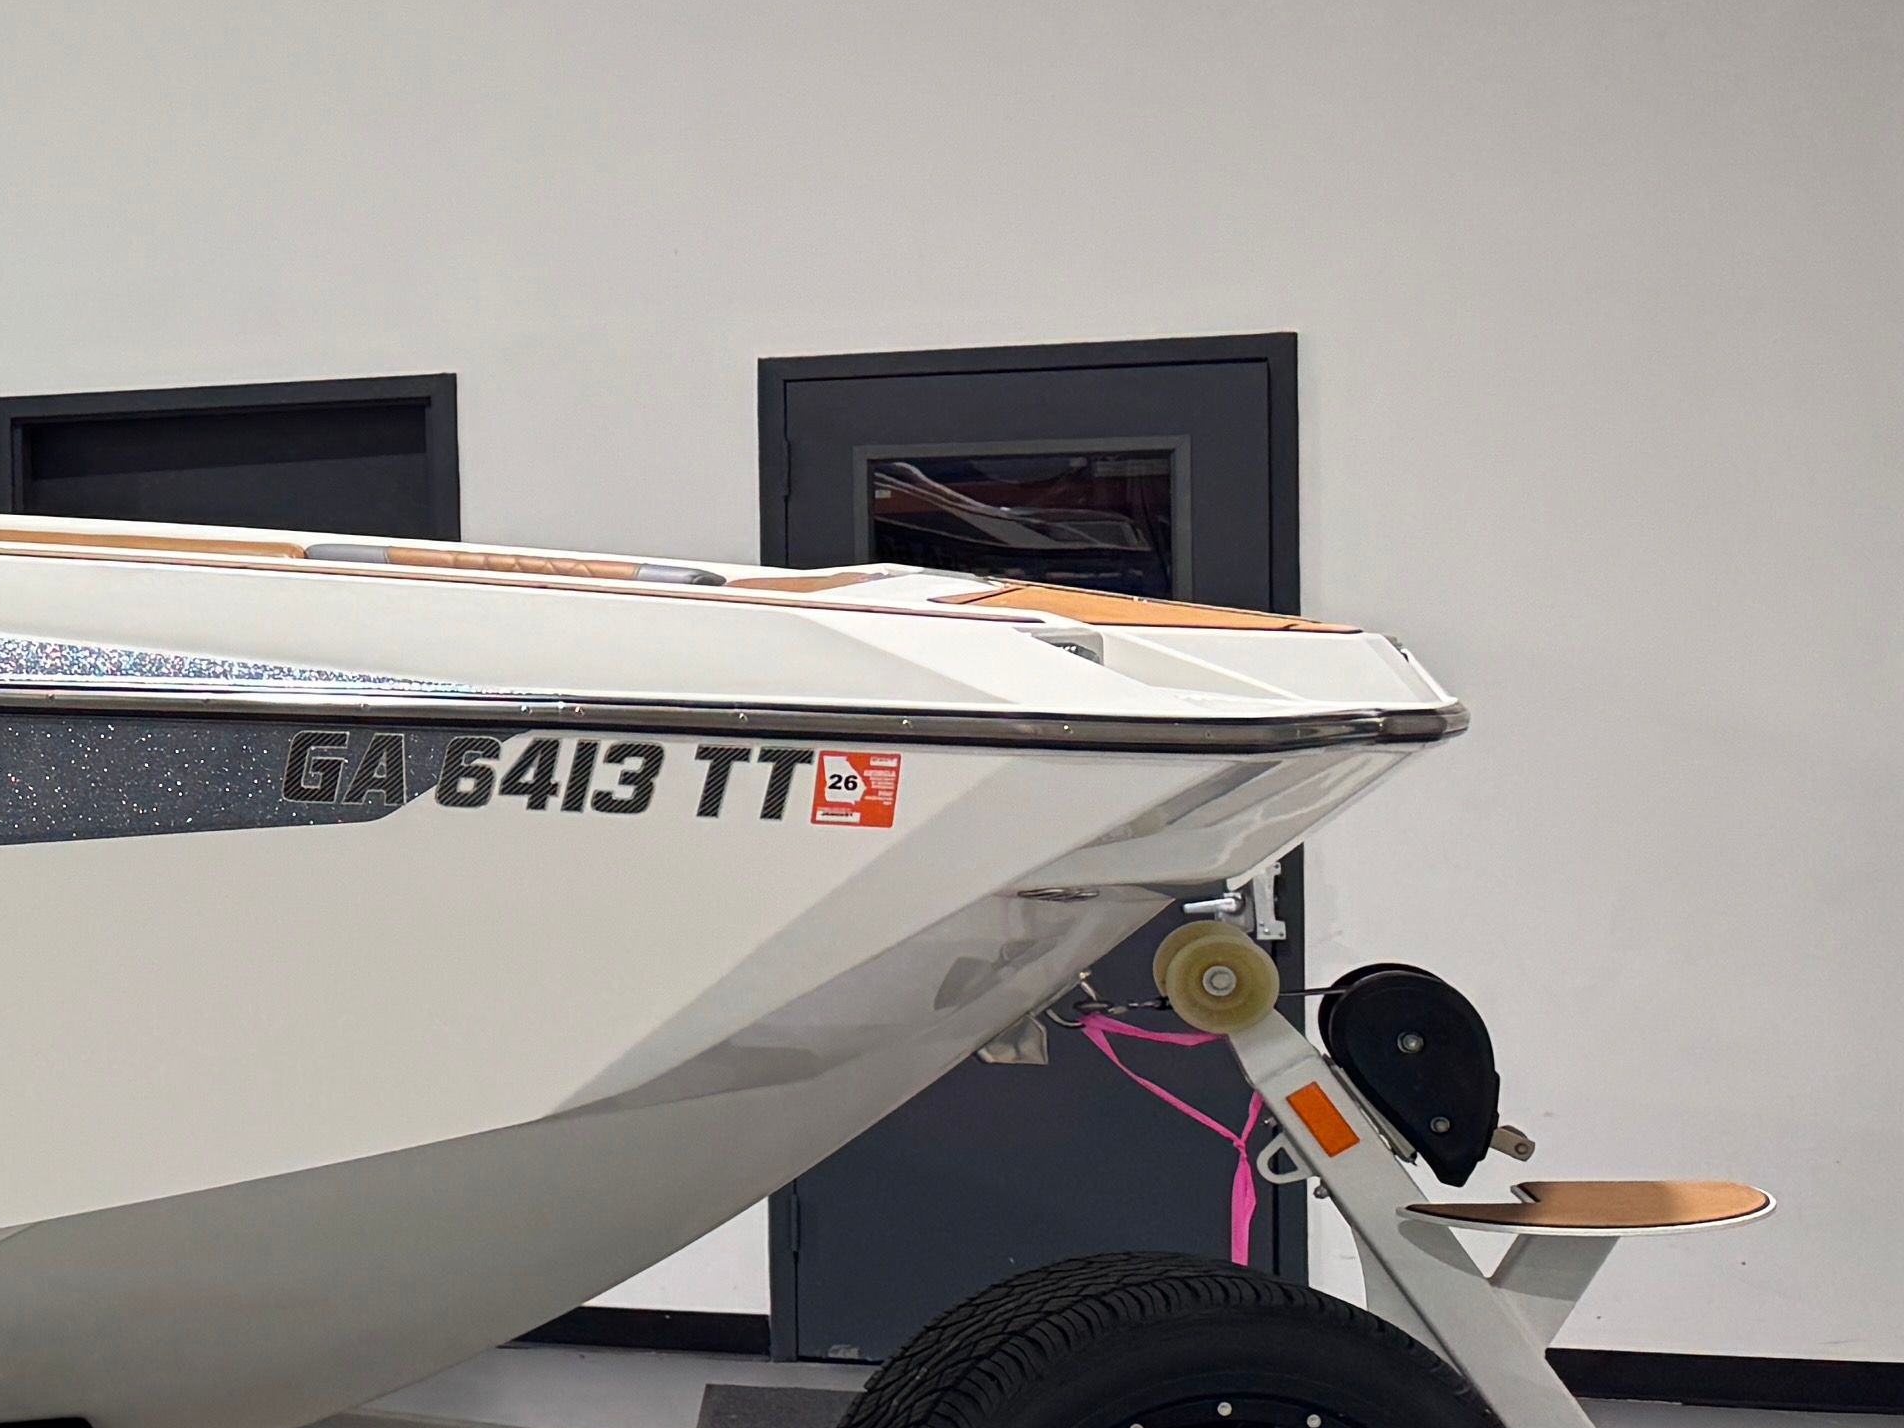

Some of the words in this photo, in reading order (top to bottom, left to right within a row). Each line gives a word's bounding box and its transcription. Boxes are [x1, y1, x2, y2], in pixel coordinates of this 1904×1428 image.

[282, 730, 408, 806] GA
[434, 735, 666, 815] 6413
[694, 743, 814, 820] TT
[827, 773, 858, 791] 26
